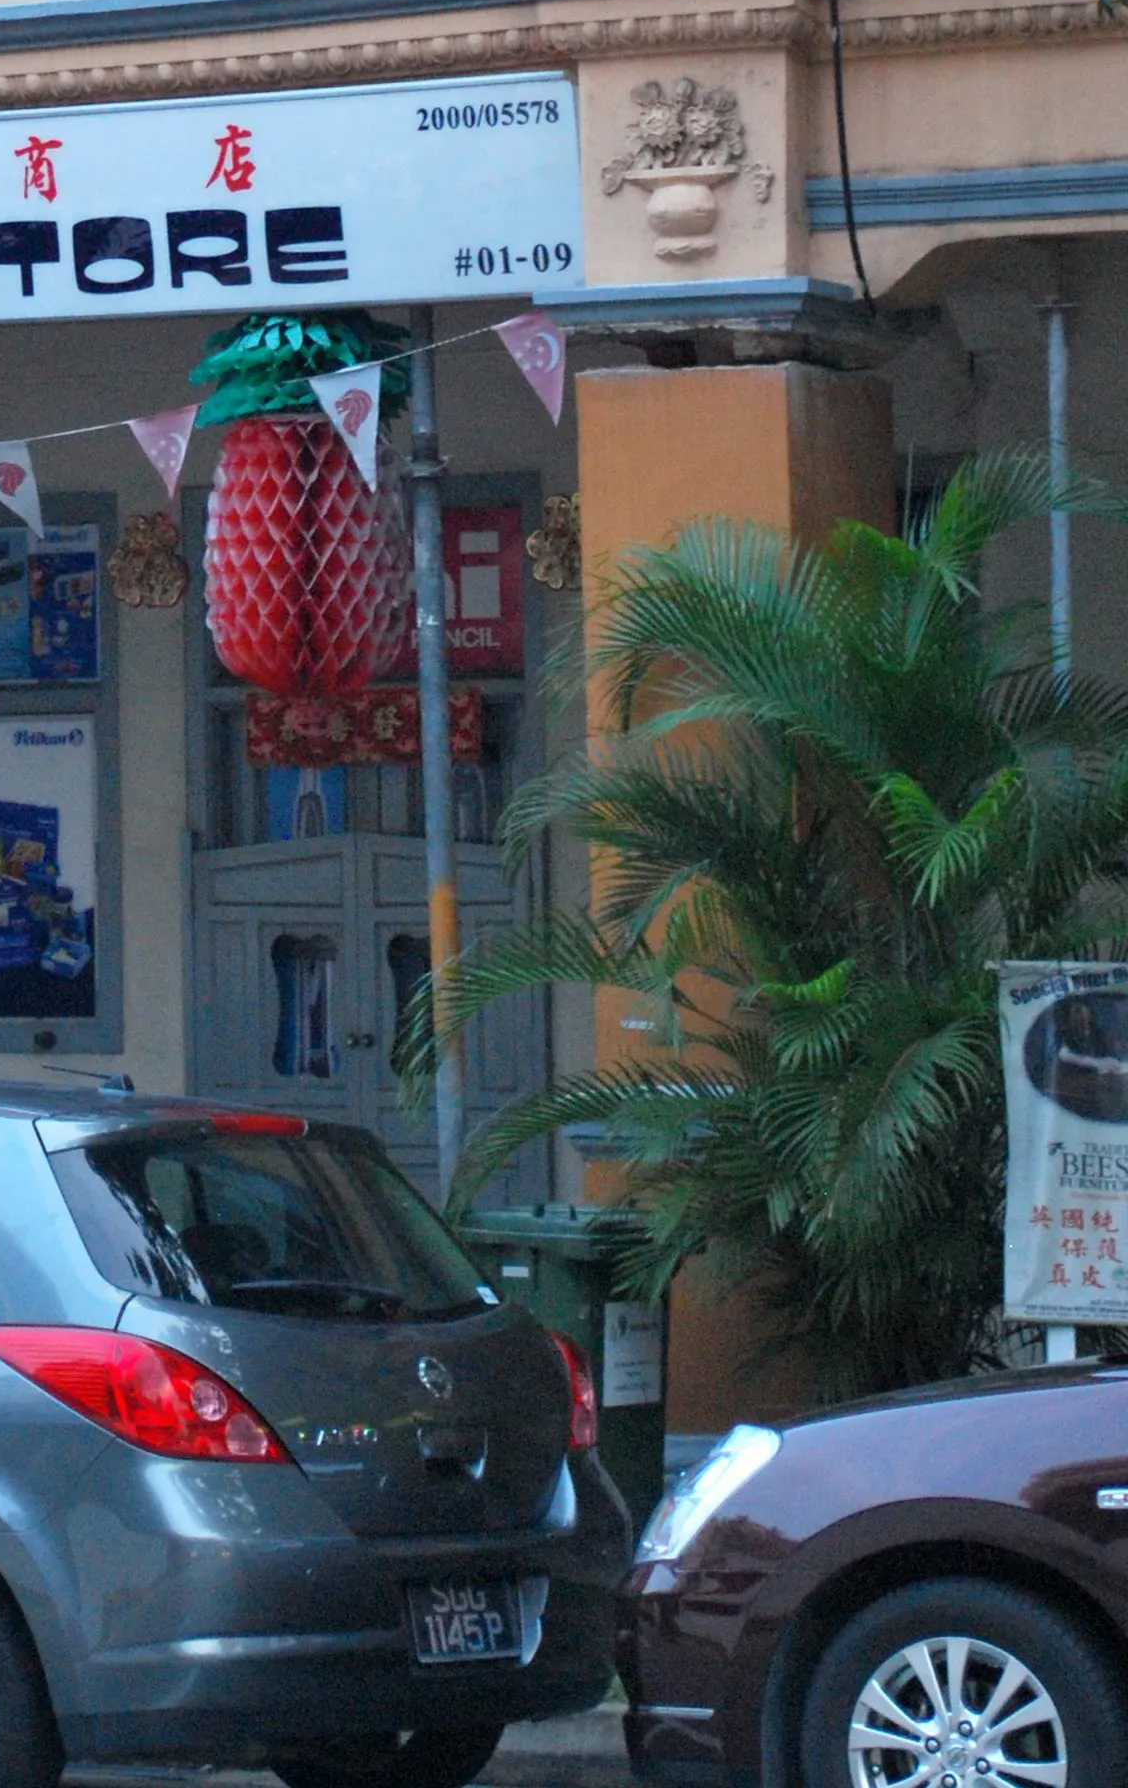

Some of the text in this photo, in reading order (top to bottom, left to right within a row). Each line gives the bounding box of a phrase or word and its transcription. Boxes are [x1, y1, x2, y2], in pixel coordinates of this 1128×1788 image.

[415, 98, 561, 133] 2000/05578
[454, 241, 574, 279] #01-09
[410, 626, 501, 649] PNCIL
[424, 1612, 504, 1653] 1145P
